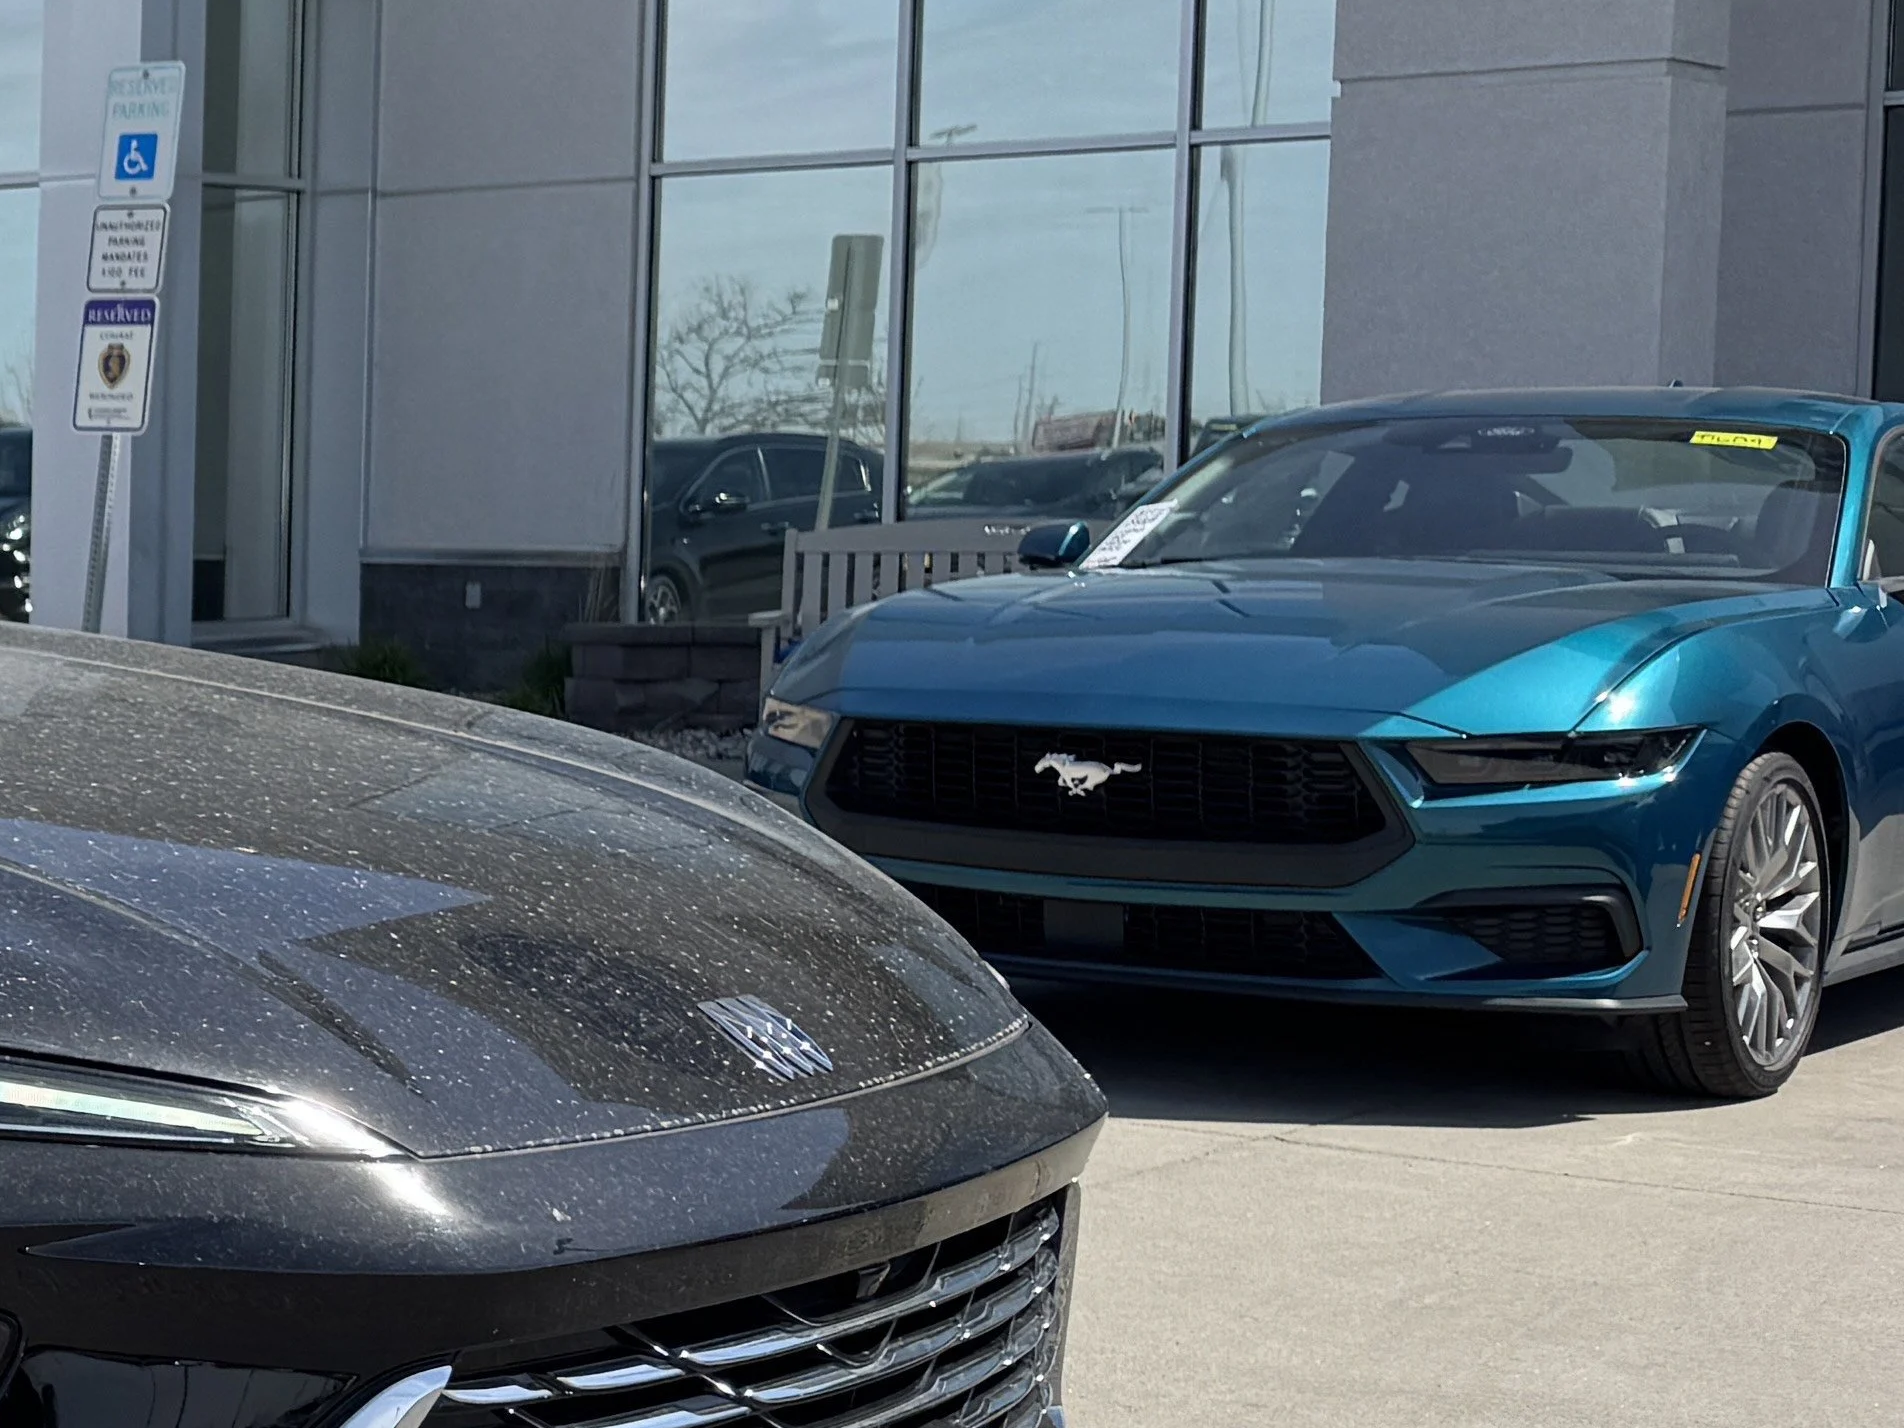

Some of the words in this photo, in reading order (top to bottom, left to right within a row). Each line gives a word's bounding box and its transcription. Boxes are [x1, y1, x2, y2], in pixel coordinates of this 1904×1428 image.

[112, 100, 170, 119] PARKING
[108, 236, 146, 247] PARKING
[101, 251, 149, 262] MANDATES
[128, 266, 145, 278] FEE
[88, 304, 152, 323] RESERVED
